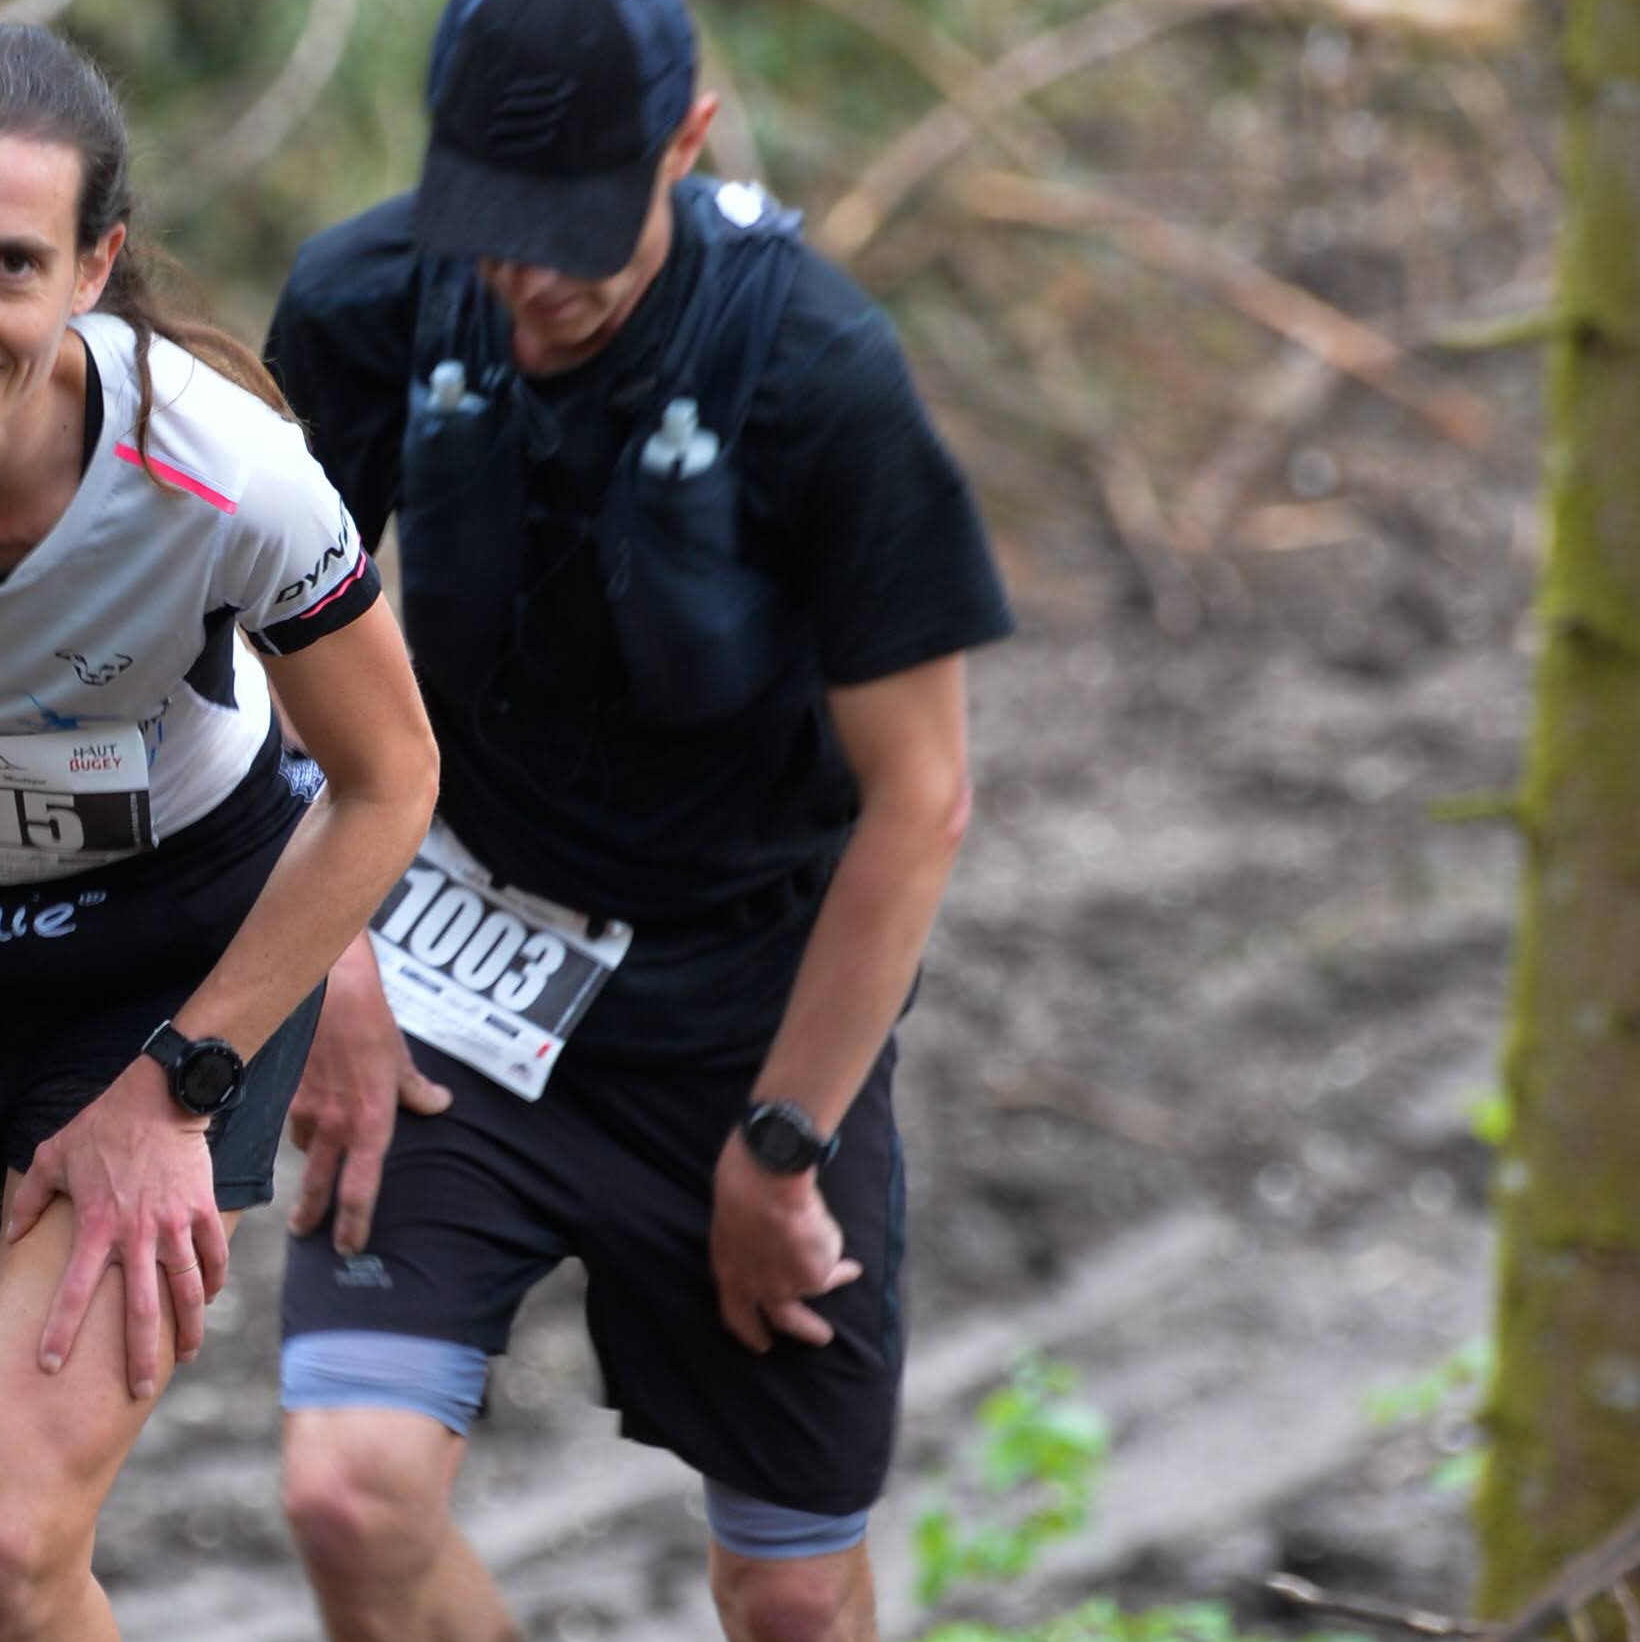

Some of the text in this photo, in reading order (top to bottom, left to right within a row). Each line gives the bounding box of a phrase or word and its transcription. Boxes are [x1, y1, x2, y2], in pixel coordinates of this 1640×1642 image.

[73, 743, 117, 759] HAUT
[69, 756, 122, 773] BUGEY
[380, 866, 568, 1014] 1003
